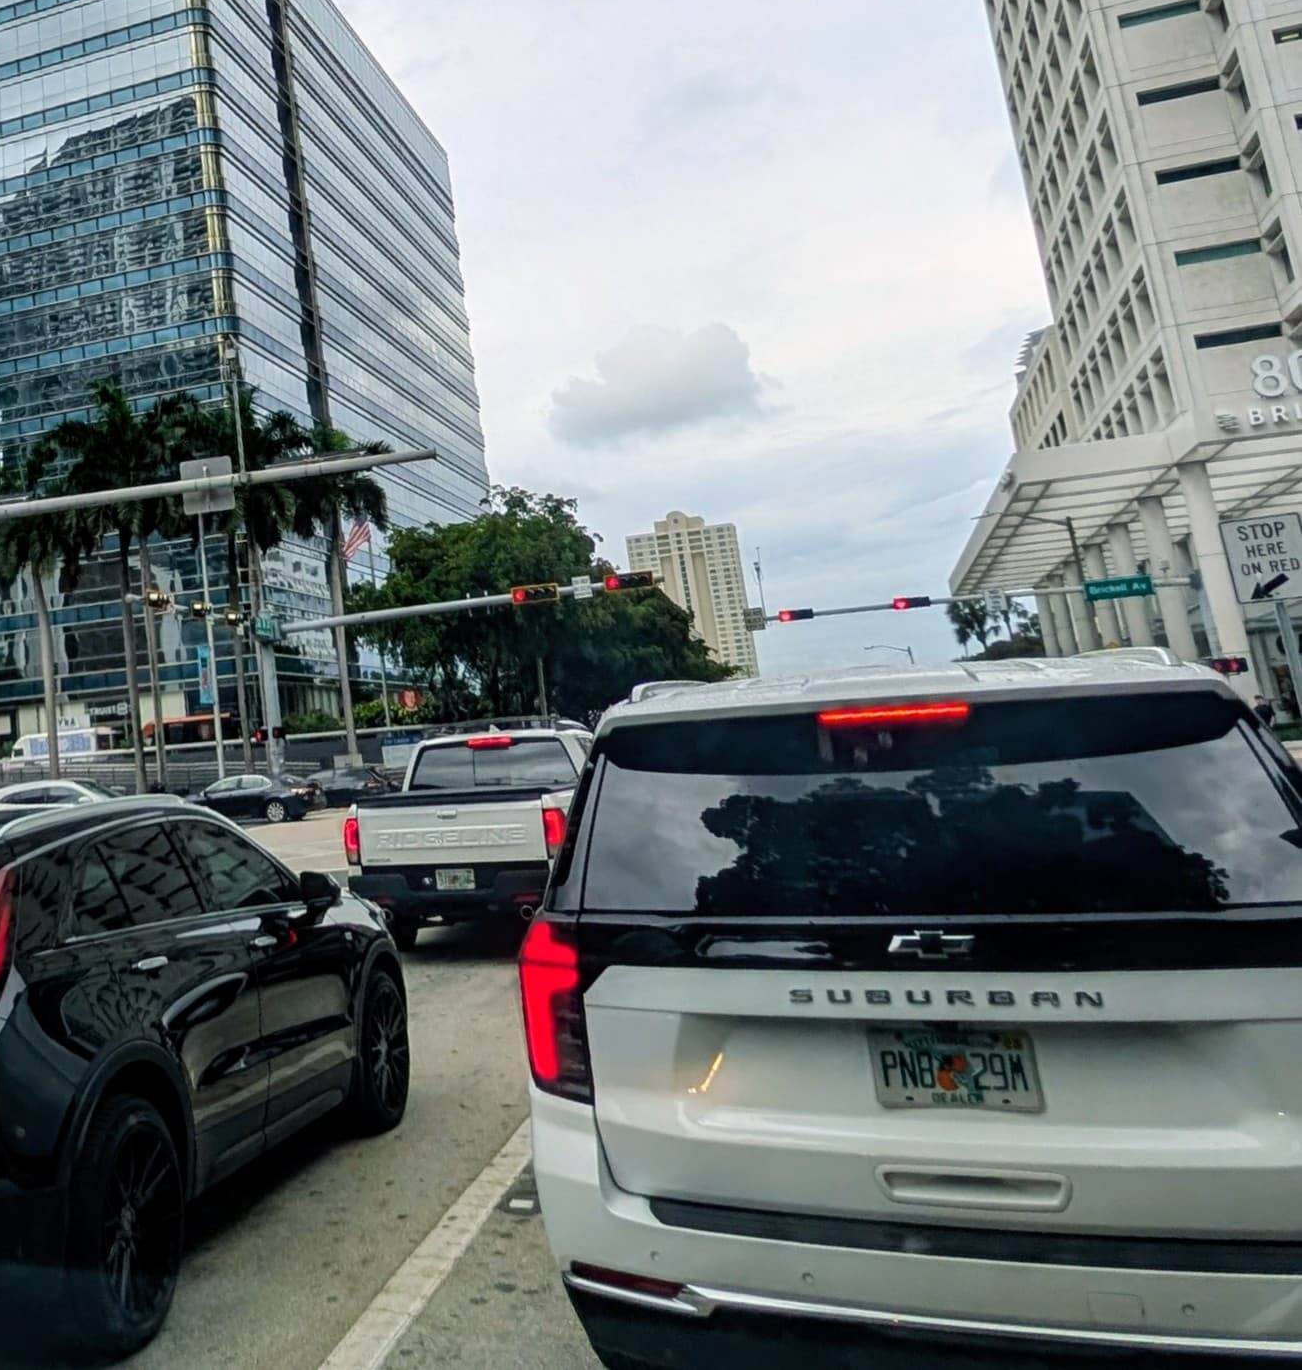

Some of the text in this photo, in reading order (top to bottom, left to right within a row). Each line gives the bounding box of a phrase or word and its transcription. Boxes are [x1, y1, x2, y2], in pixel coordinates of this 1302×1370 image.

[1236, 522, 1285, 541] STOP
[1245, 541, 1287, 558] HERE
[1241, 558, 1301, 576] ON RED
[376, 827, 527, 849] RIDGELINE
[788, 988, 1104, 1007] SUBURBAN
[970, 1053, 1029, 1091] 29M
